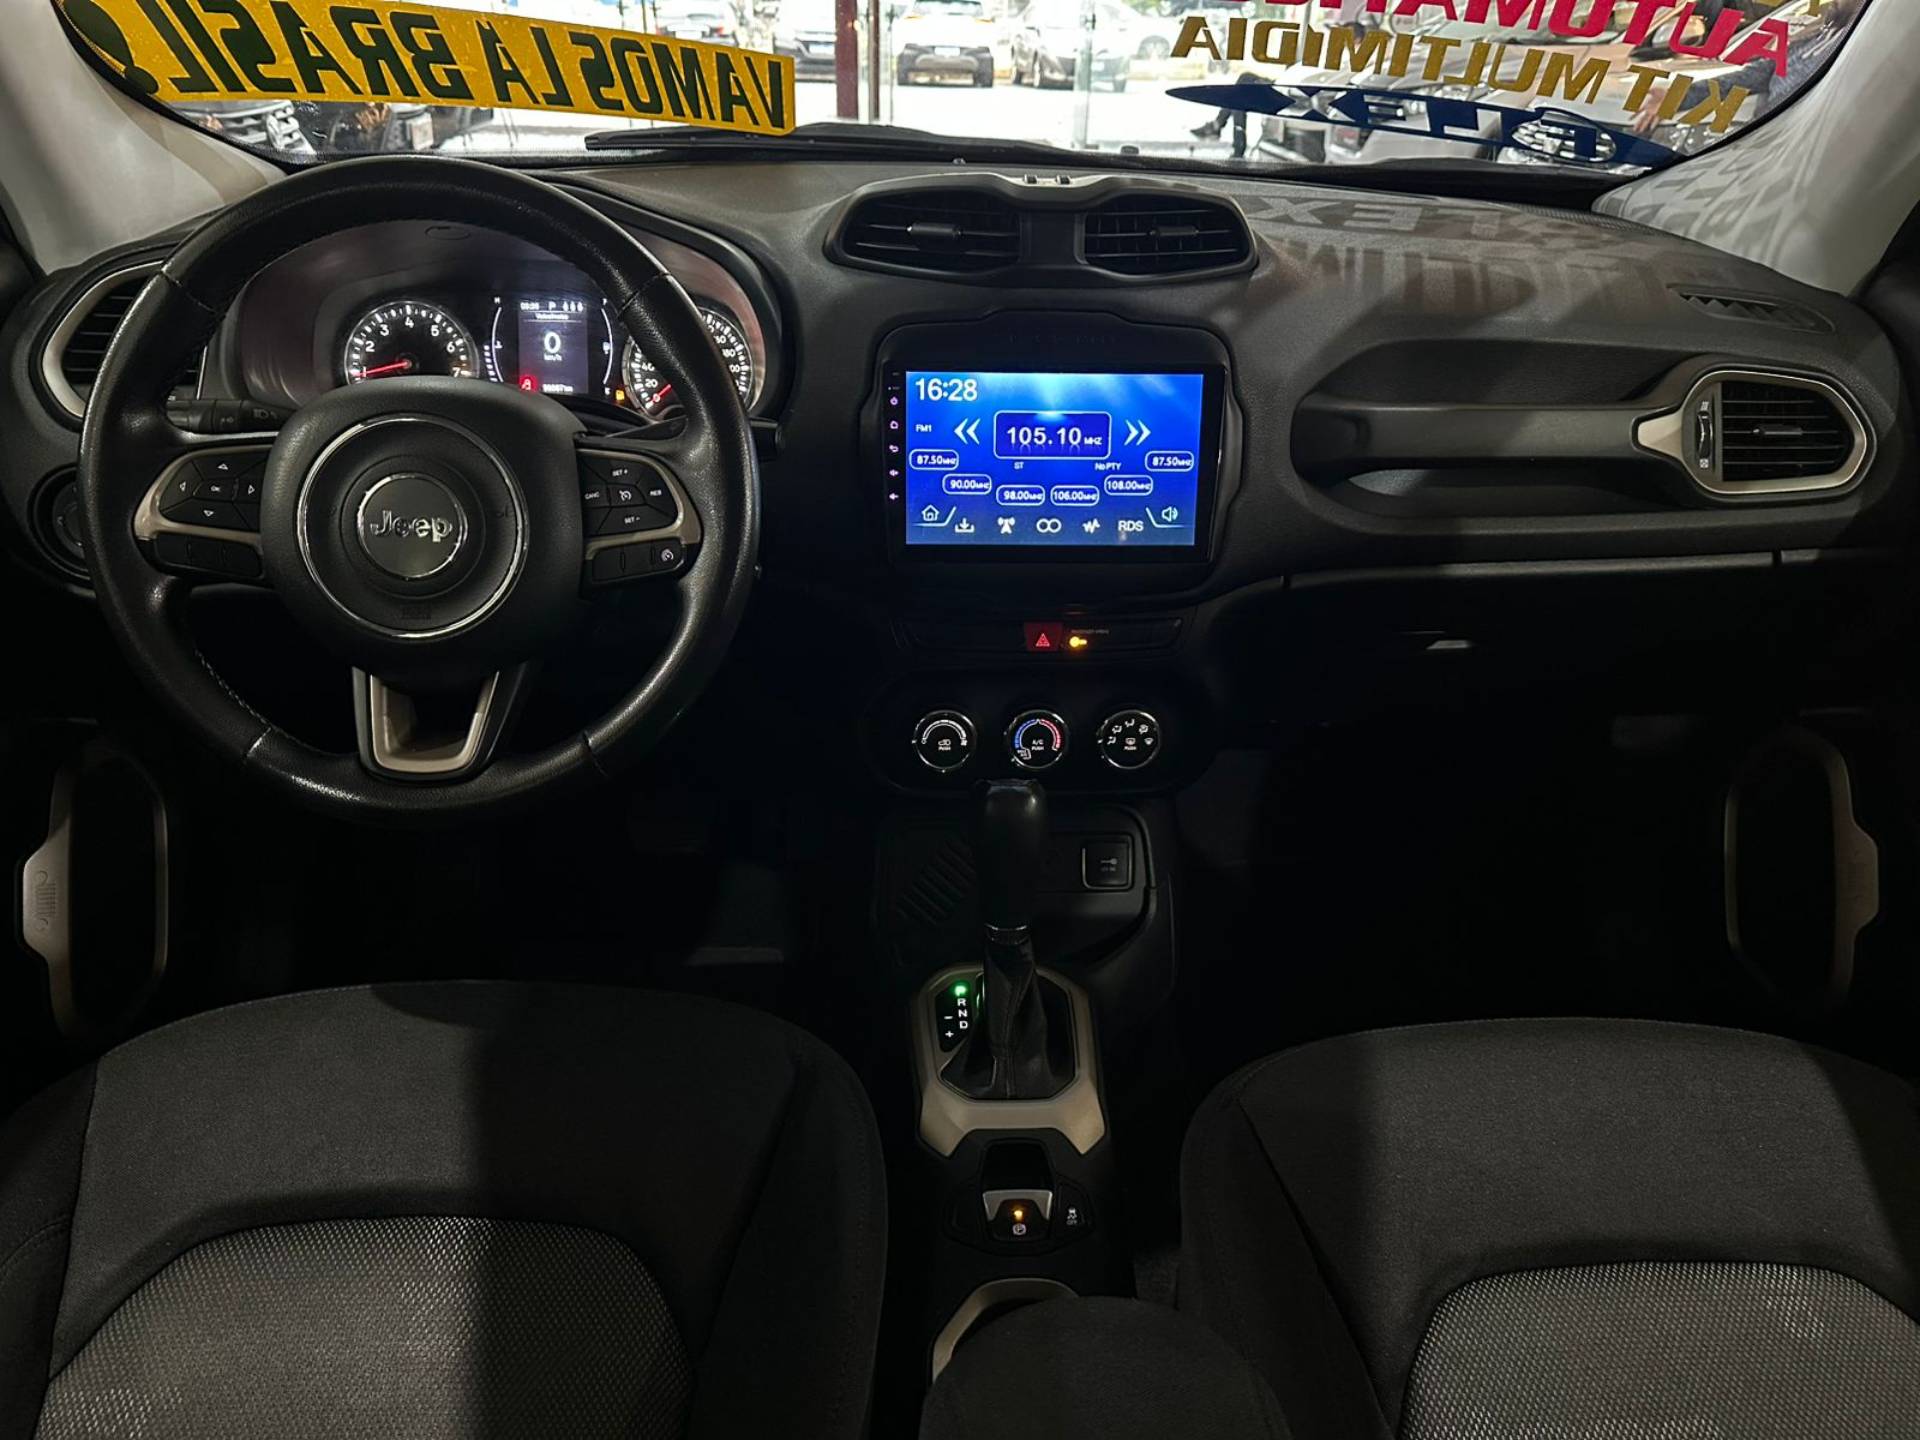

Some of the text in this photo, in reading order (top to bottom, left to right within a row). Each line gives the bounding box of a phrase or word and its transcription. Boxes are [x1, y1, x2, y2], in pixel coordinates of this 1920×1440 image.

[404, 316, 415, 328] 4
[379, 323, 390, 336] 3
[430, 324, 440, 337] 5
[365, 340, 375, 352] 2
[446, 344, 456, 353] 6
[544, 331, 561, 354] 0
[452, 366, 461, 378] 7
[645, 378, 659, 388] 20
[915, 377, 978, 402] 16:28
[916, 424, 932, 433] FM1
[1006, 426, 1083, 446] 105.10
[369, 510, 453, 542] Jeep
[1117, 520, 1144, 532] RDS
[957, 998, 967, 1007] R
[958, 1009, 968, 1018] N
[959, 1020, 968, 1029] D
